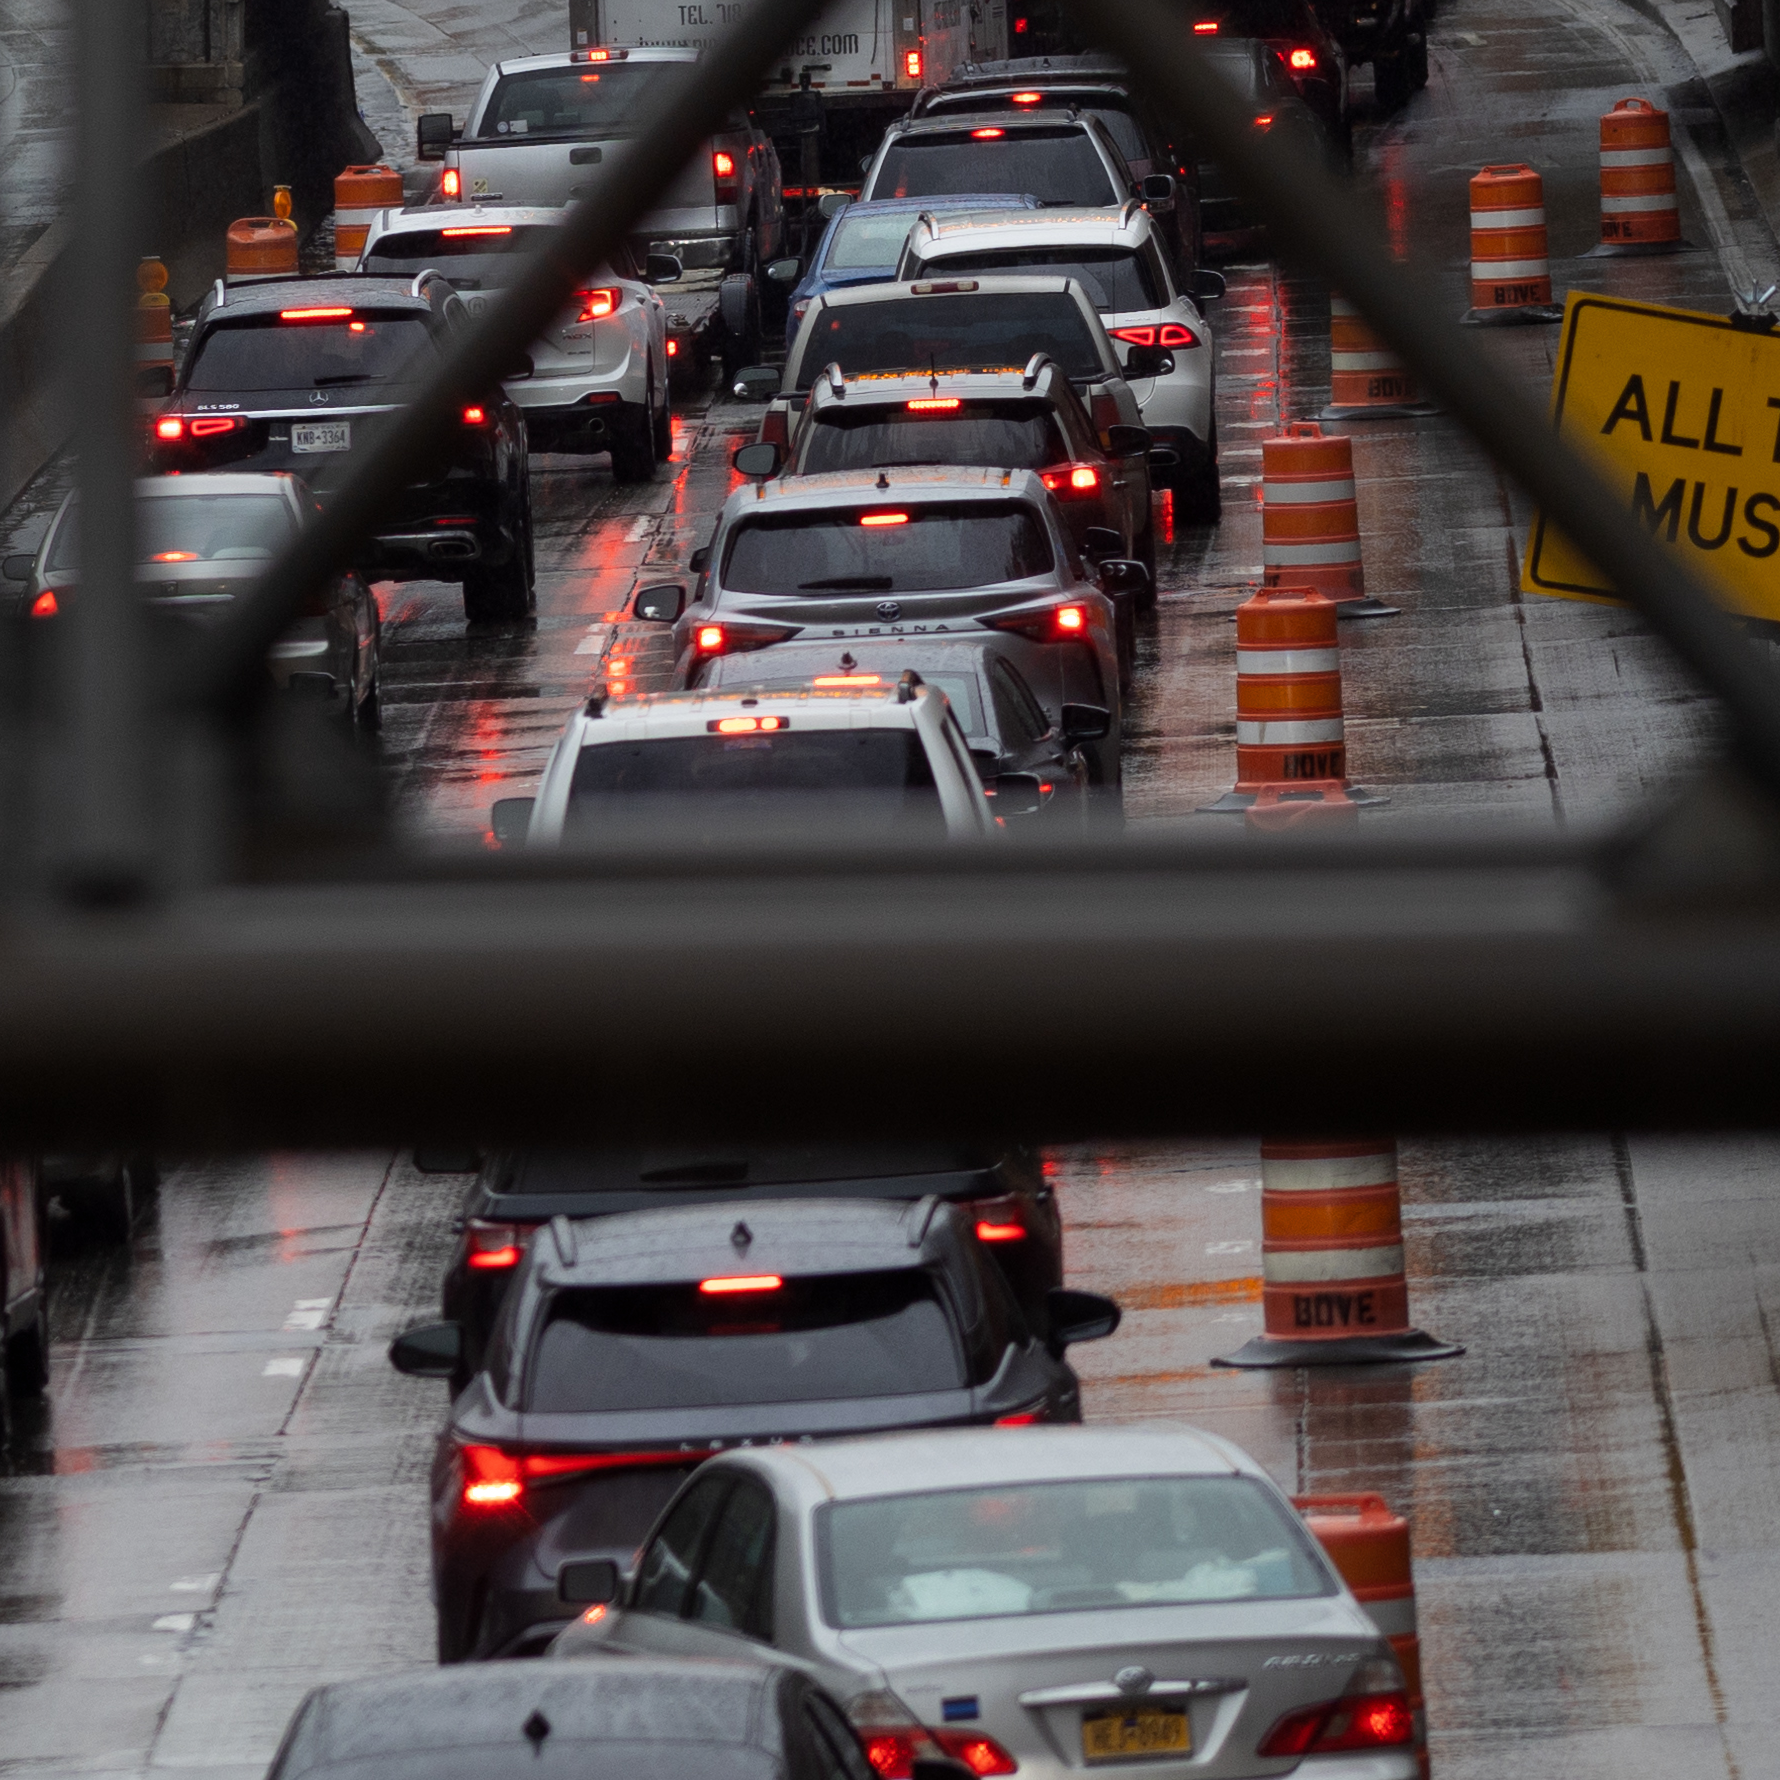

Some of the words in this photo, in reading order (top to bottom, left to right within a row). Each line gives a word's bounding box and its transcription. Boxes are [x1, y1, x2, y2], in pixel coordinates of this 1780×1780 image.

[678, 5, 713, 26] TEL.
[1601, 374, 1743, 456] ALL
[831, 623, 950, 638] SIENNA
[1294, 1291, 1376, 1327] BOVE
